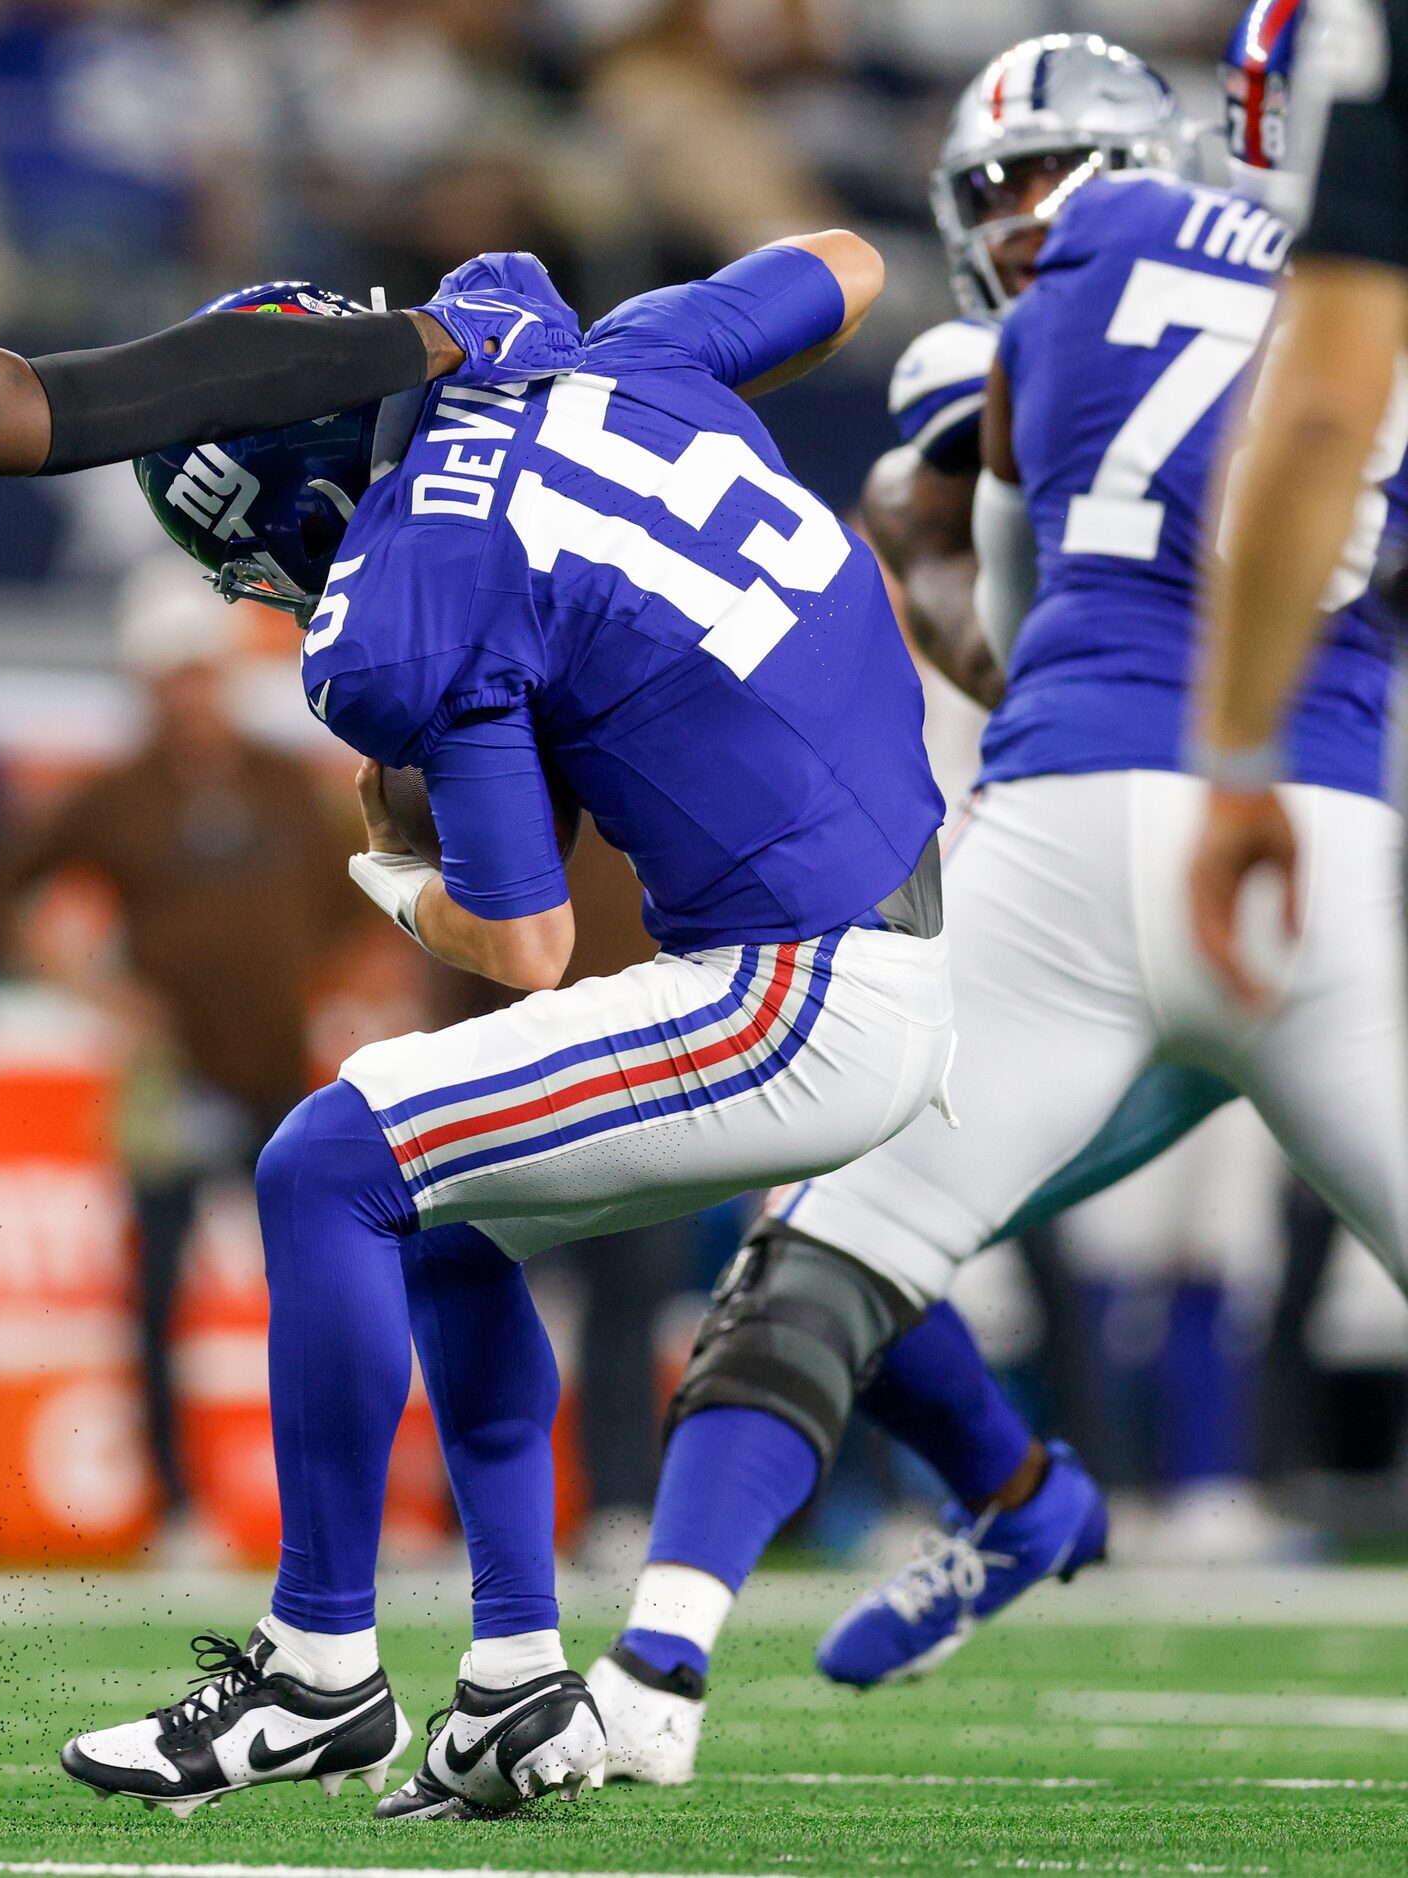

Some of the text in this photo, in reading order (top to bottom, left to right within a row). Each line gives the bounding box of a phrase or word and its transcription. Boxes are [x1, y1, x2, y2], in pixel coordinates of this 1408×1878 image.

[1175, 189, 1295, 276] THO
[411, 382, 529, 521] DEVI
[506, 373, 852, 682] 15
